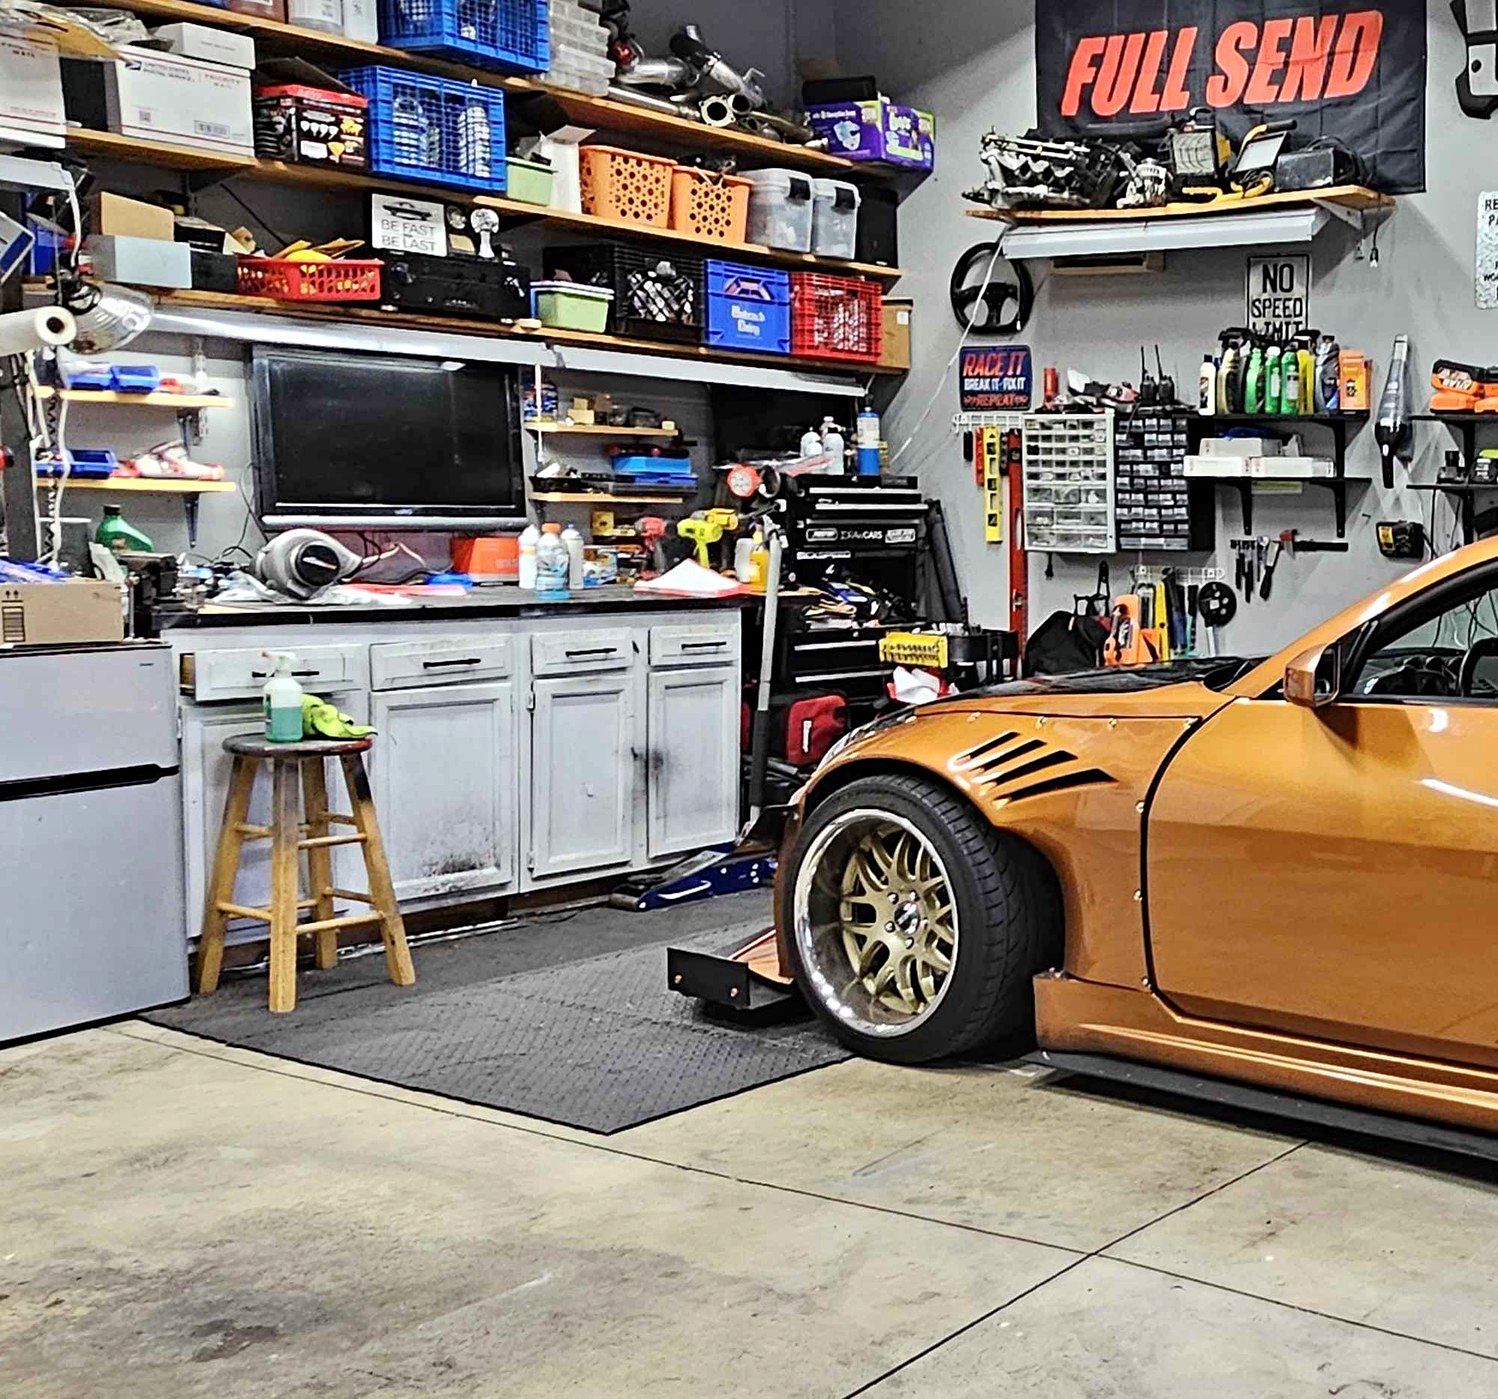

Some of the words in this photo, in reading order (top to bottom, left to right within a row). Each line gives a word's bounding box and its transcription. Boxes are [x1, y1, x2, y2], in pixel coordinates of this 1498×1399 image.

[1061, 27, 1198, 116] FULL
[1206, 10, 1384, 109] SEND
[381, 219, 399, 231] BE
[402, 222, 436, 236] FAST
[382, 235, 400, 247] BE
[402, 238, 436, 252] LAST
[1262, 263, 1294, 293] NO
[1252, 297, 1303, 318] SPEED
[963, 352, 1008, 376] RACE
[1007, 351, 1027, 375] IT
[964, 377, 990, 390] BREAK
[991, 377, 1000, 390] IT
[1003, 377, 1016, 390] FIX
[1017, 376, 1026, 390] IT
